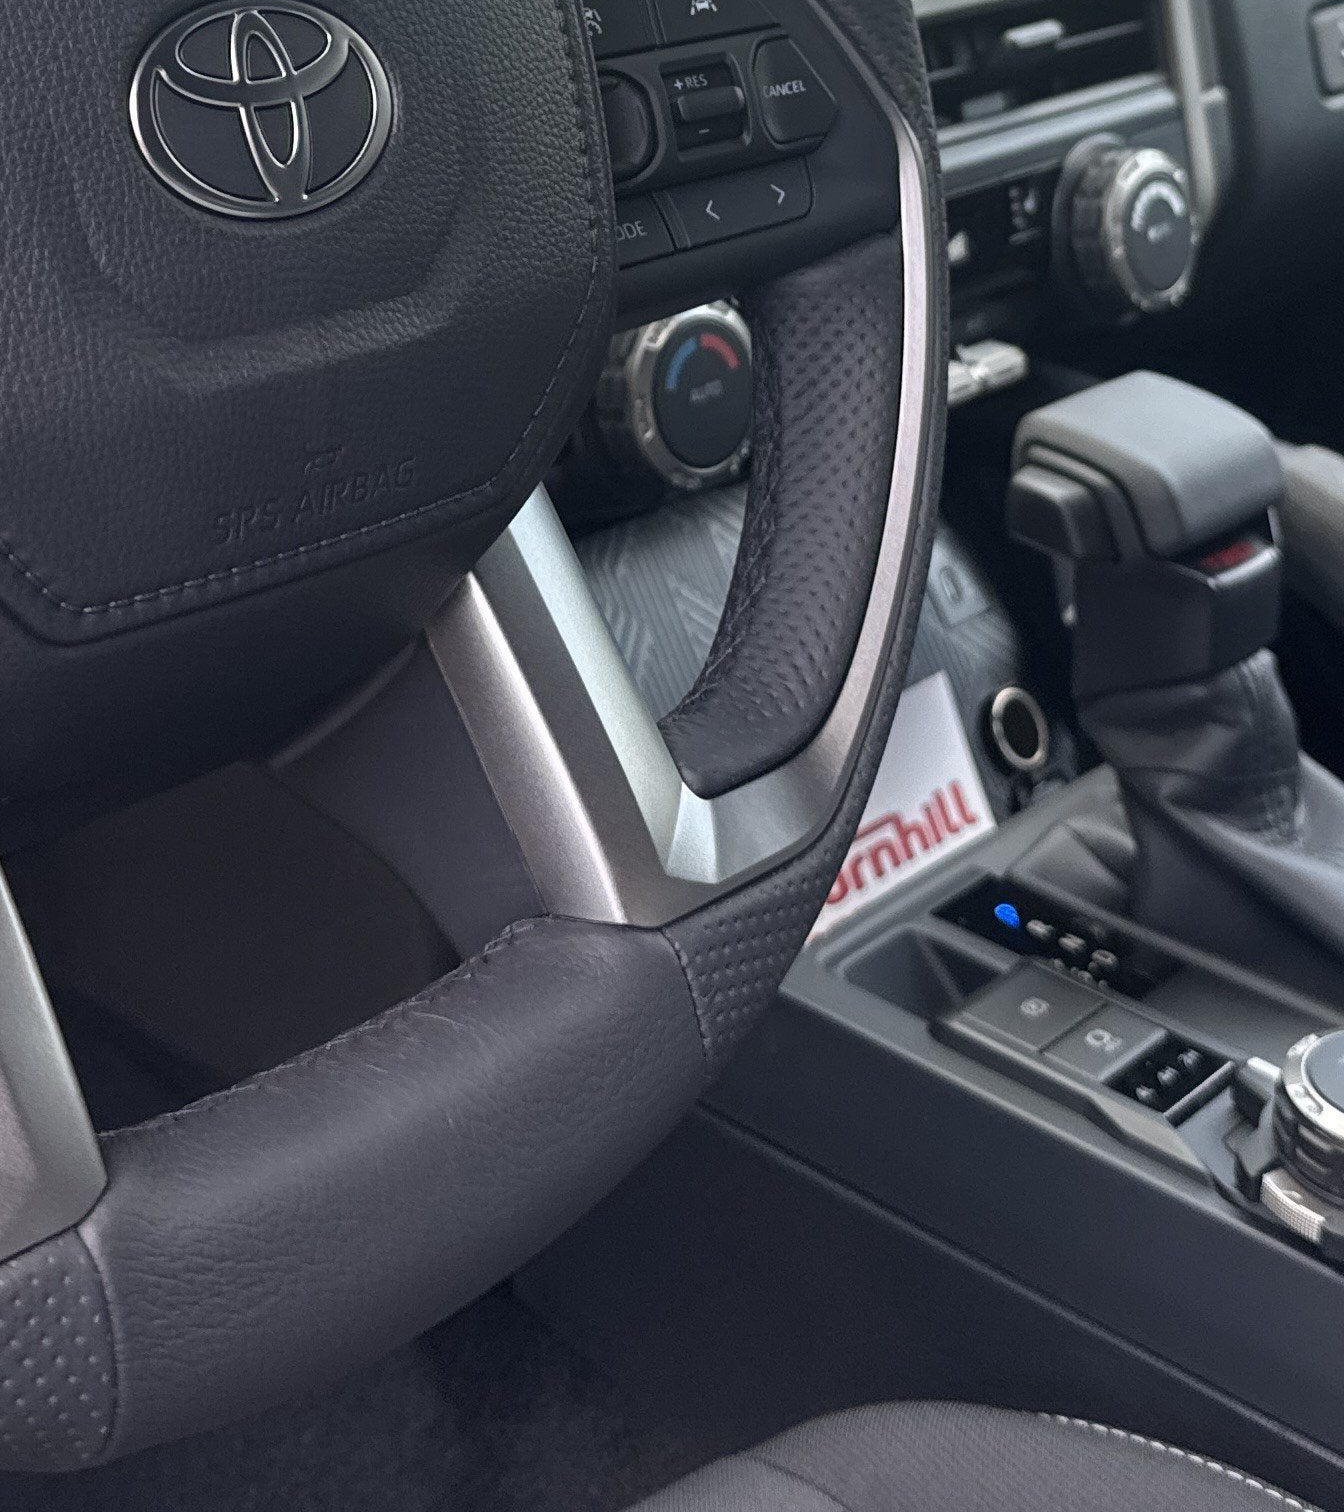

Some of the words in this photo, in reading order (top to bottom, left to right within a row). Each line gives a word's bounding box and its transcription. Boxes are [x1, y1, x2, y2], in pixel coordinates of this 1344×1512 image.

[762, 80, 807, 97] CANCEL
[613, 220, 648, 241] ODE
[826, 780, 978, 905] ornhill
